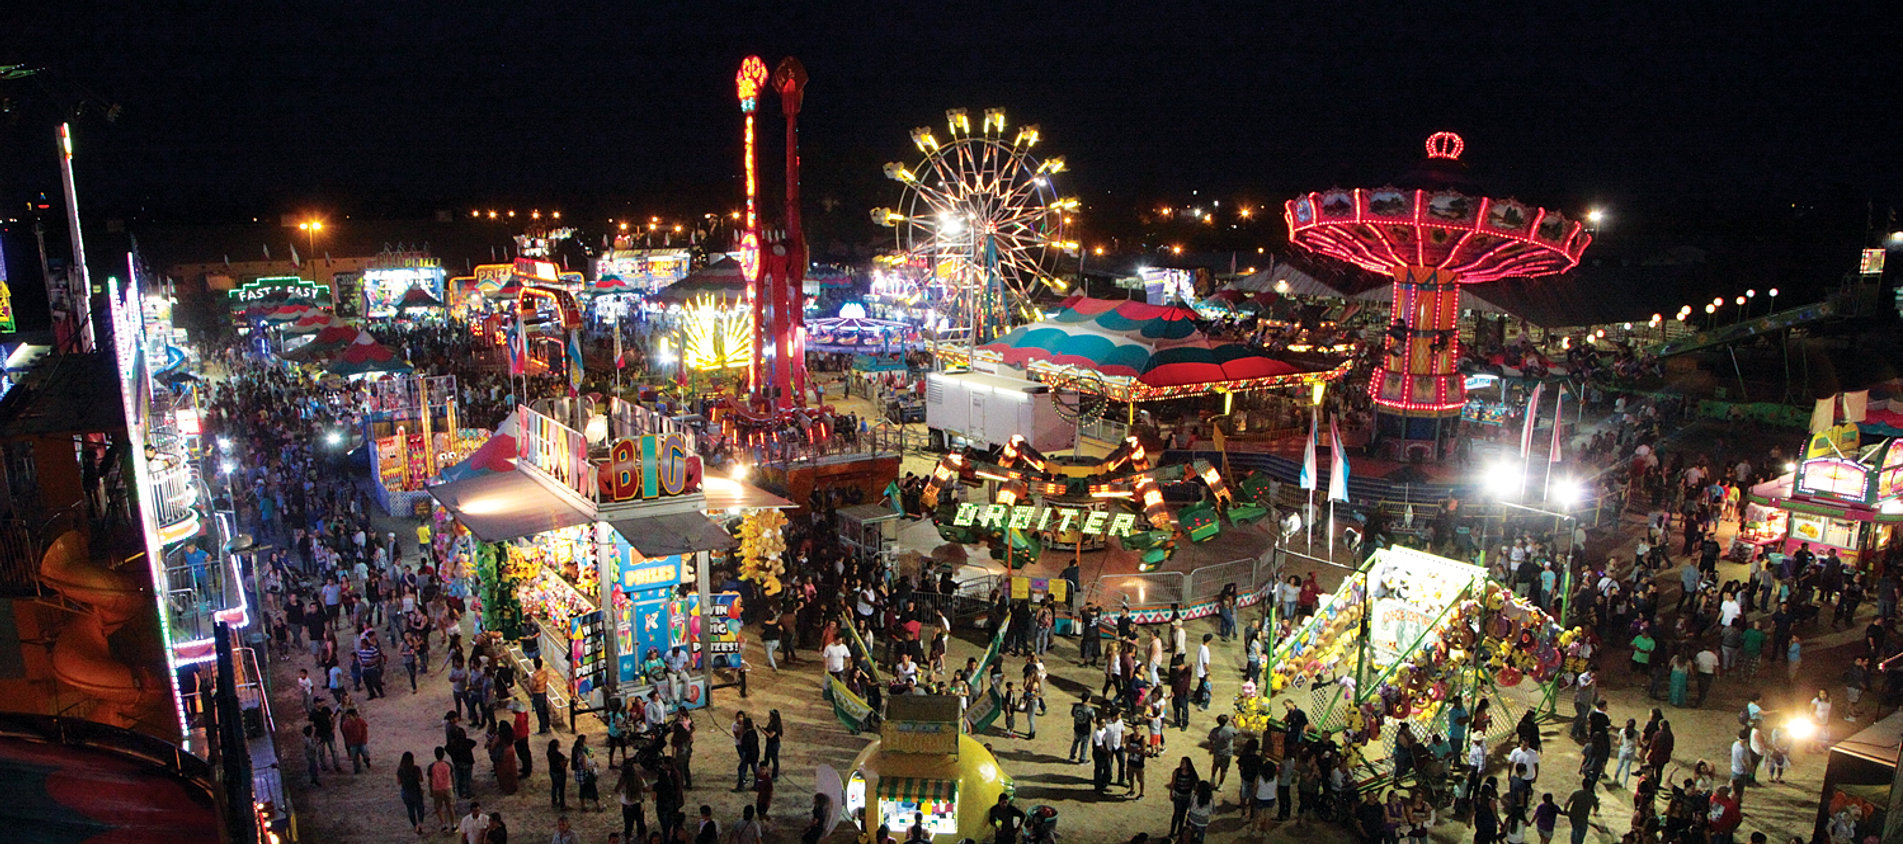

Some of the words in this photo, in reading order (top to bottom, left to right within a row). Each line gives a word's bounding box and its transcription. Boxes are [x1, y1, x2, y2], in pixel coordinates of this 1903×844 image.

[239, 287, 272, 302] FAST
[287, 285, 319, 299] EASY
[611, 433, 686, 501] BIG
[953, 502, 1136, 538] ORBITER
[625, 565, 676, 587] PRIZES
[582, 621, 603, 637] WIN
[584, 640, 604, 656] BIG
[692, 642, 739, 652] PIZES!
